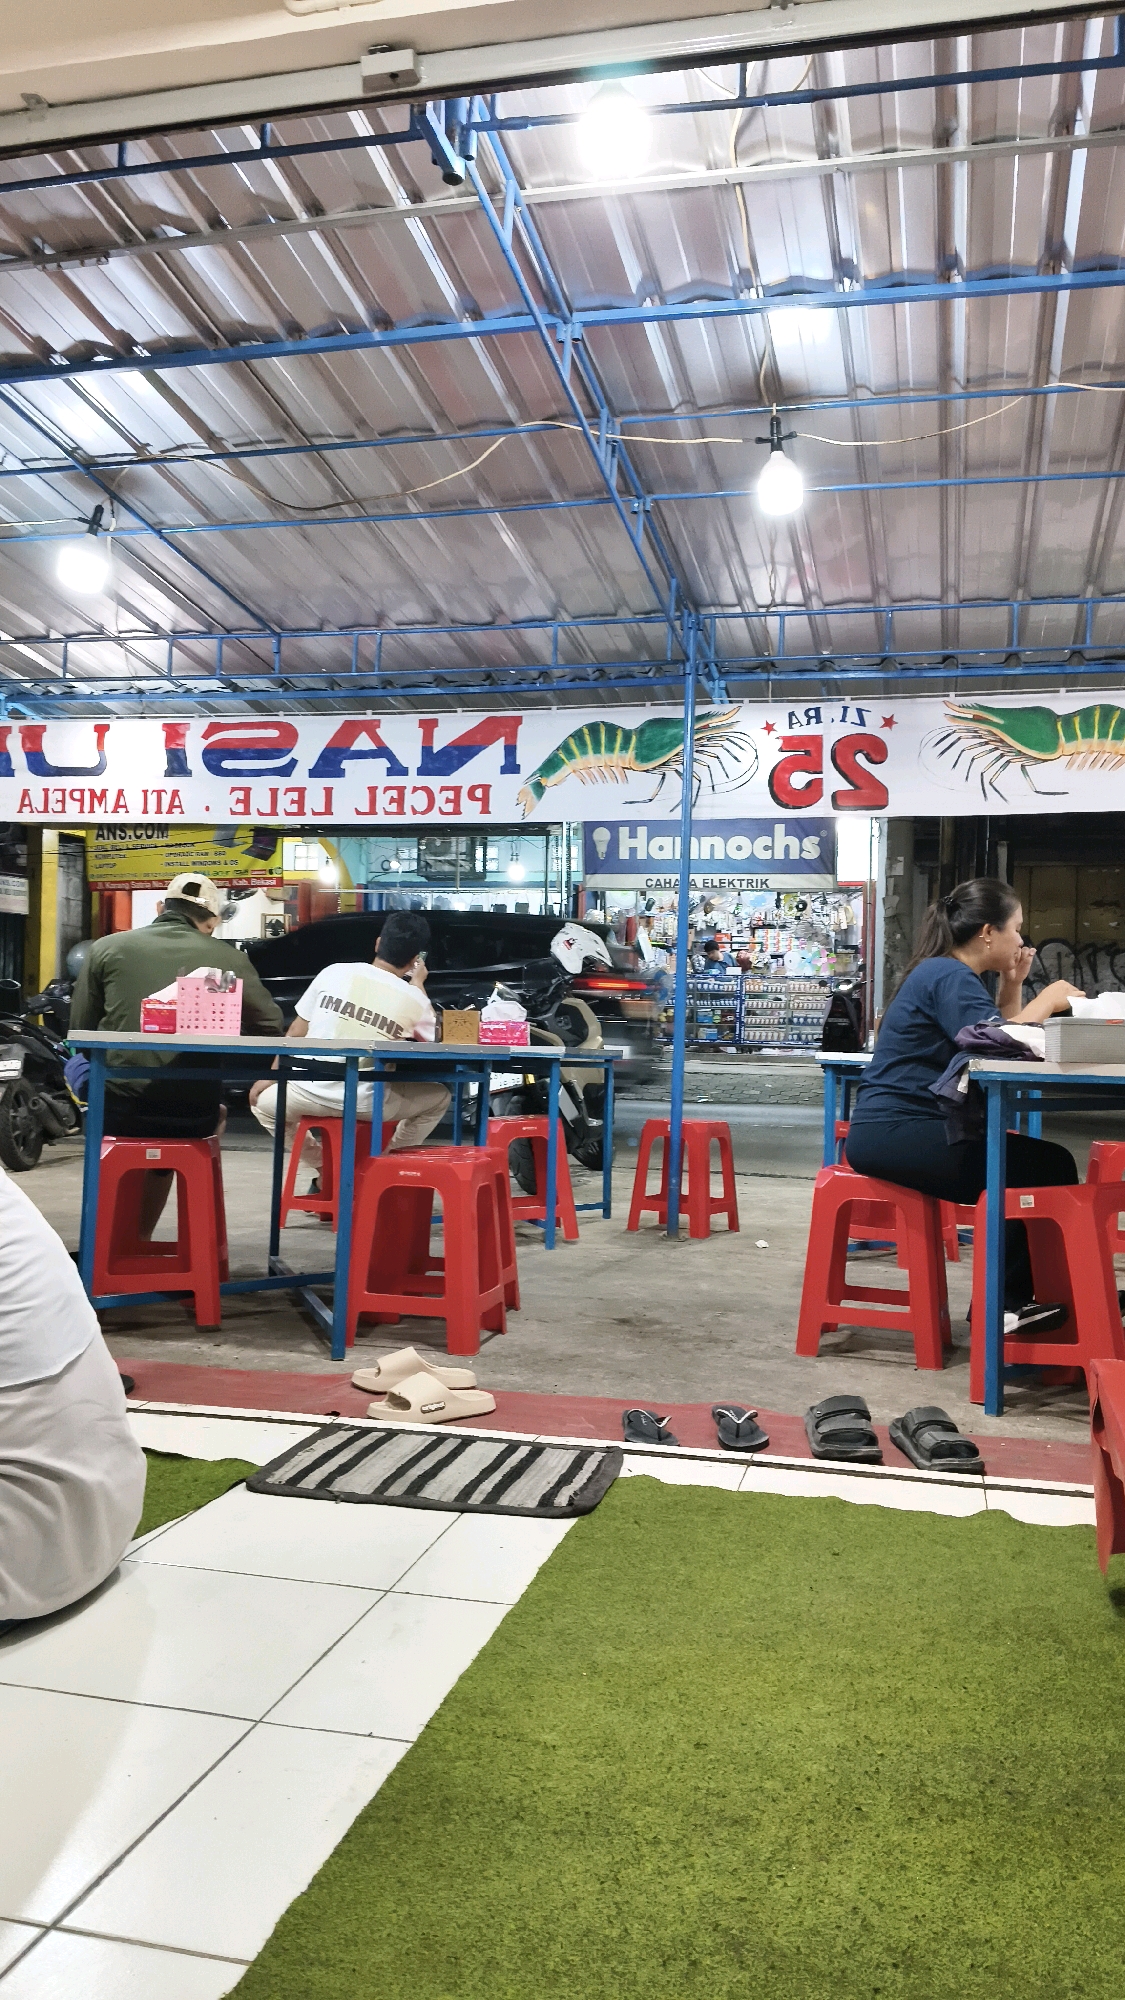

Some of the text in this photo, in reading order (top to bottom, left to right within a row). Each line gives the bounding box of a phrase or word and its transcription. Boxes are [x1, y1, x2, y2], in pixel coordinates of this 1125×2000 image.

[95, 823, 169, 841] ANS.COM
[618, 824, 821, 860] Hannochs
[251, 877, 277, 886] Bekasi
[646, 878, 769, 889] CAHAA ELEKTRIK
[319, 994, 404, 1040] IMAGINE
